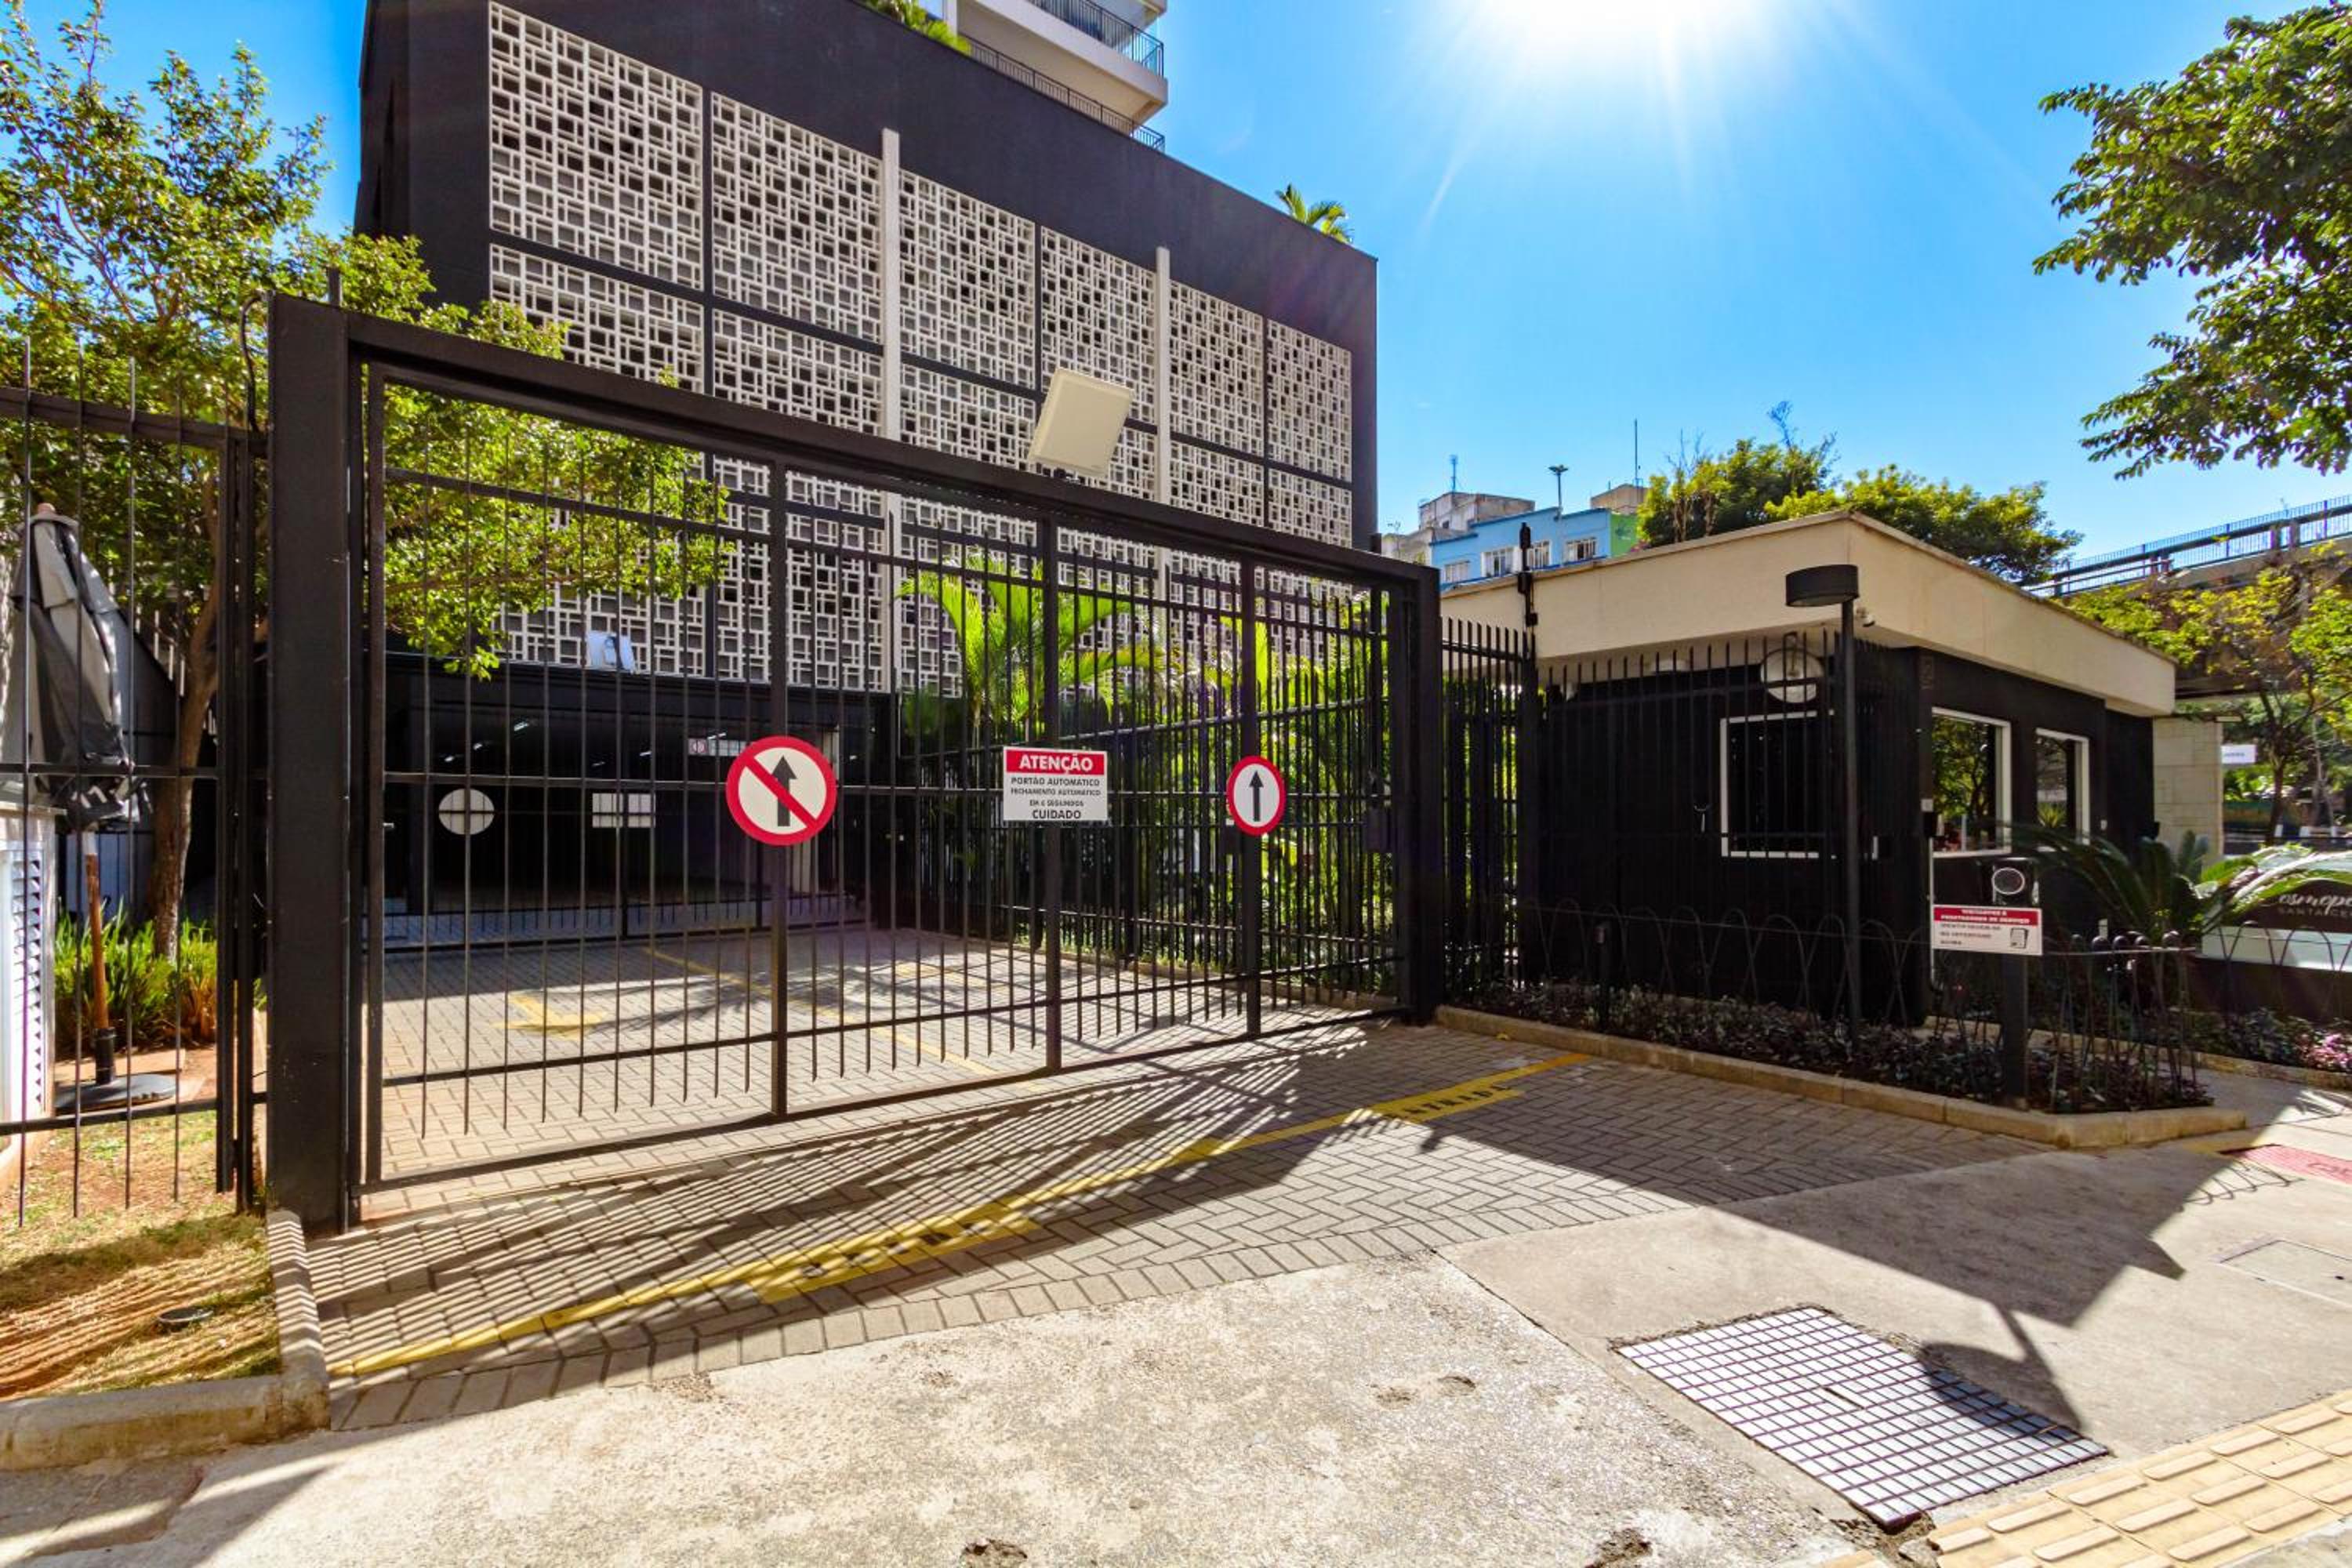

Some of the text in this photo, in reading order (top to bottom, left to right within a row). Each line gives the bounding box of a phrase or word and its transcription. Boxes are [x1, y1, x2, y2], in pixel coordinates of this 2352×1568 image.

[1019, 753, 1094, 775] ATENÇÃO
[1011, 776, 1045, 785] PORTÃO
[1032, 809, 1082, 819] CUIDADO
